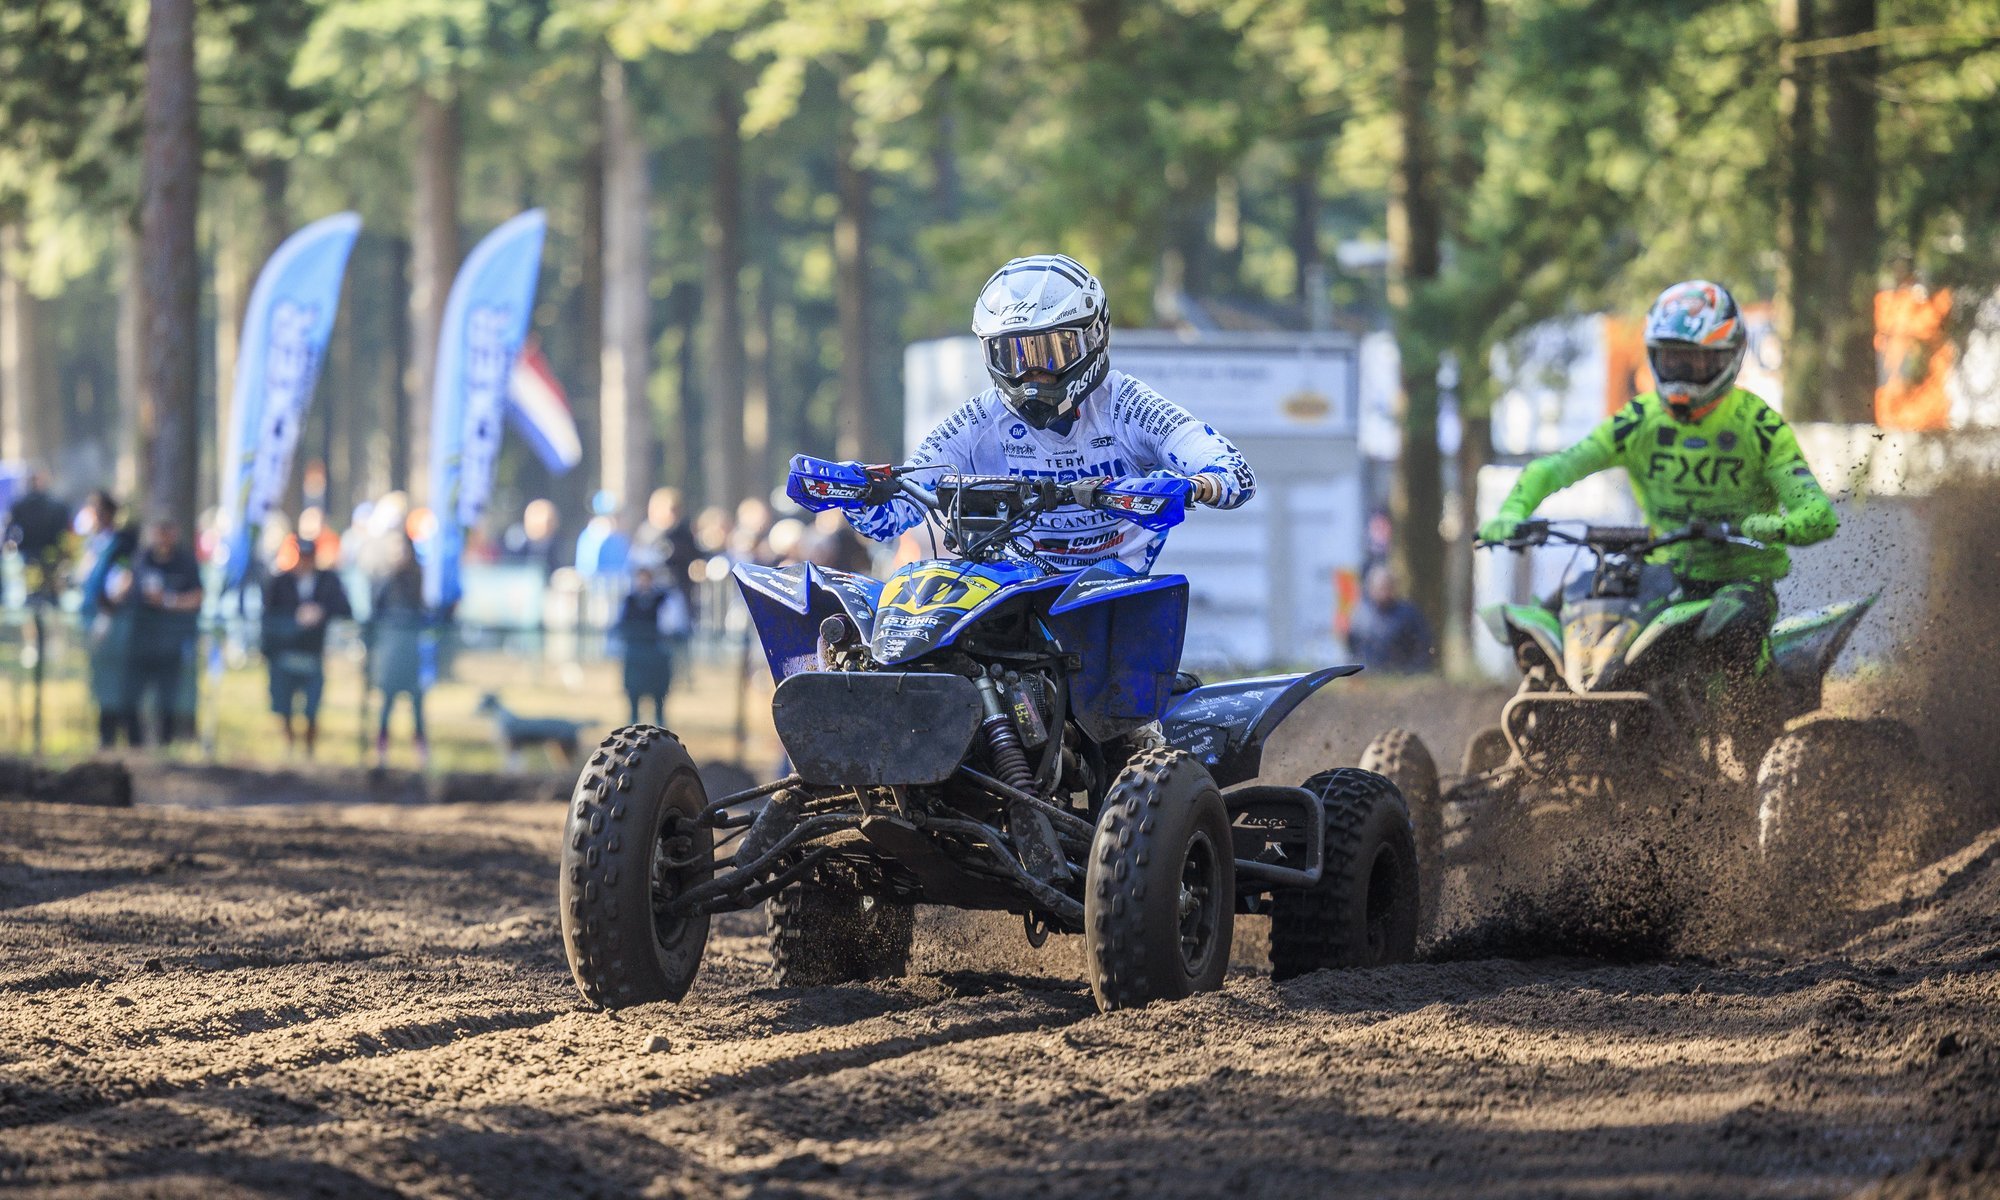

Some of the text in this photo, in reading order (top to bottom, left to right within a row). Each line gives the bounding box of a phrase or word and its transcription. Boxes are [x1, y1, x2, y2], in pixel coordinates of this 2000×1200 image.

[1012, 428, 1024, 436] EMF
[1045, 455, 1084, 468] TEAM
[1648, 452, 1746, 486] FXR
[1044, 555, 1068, 566] LAURI
[882, 615, 939, 626] ESTONIA
